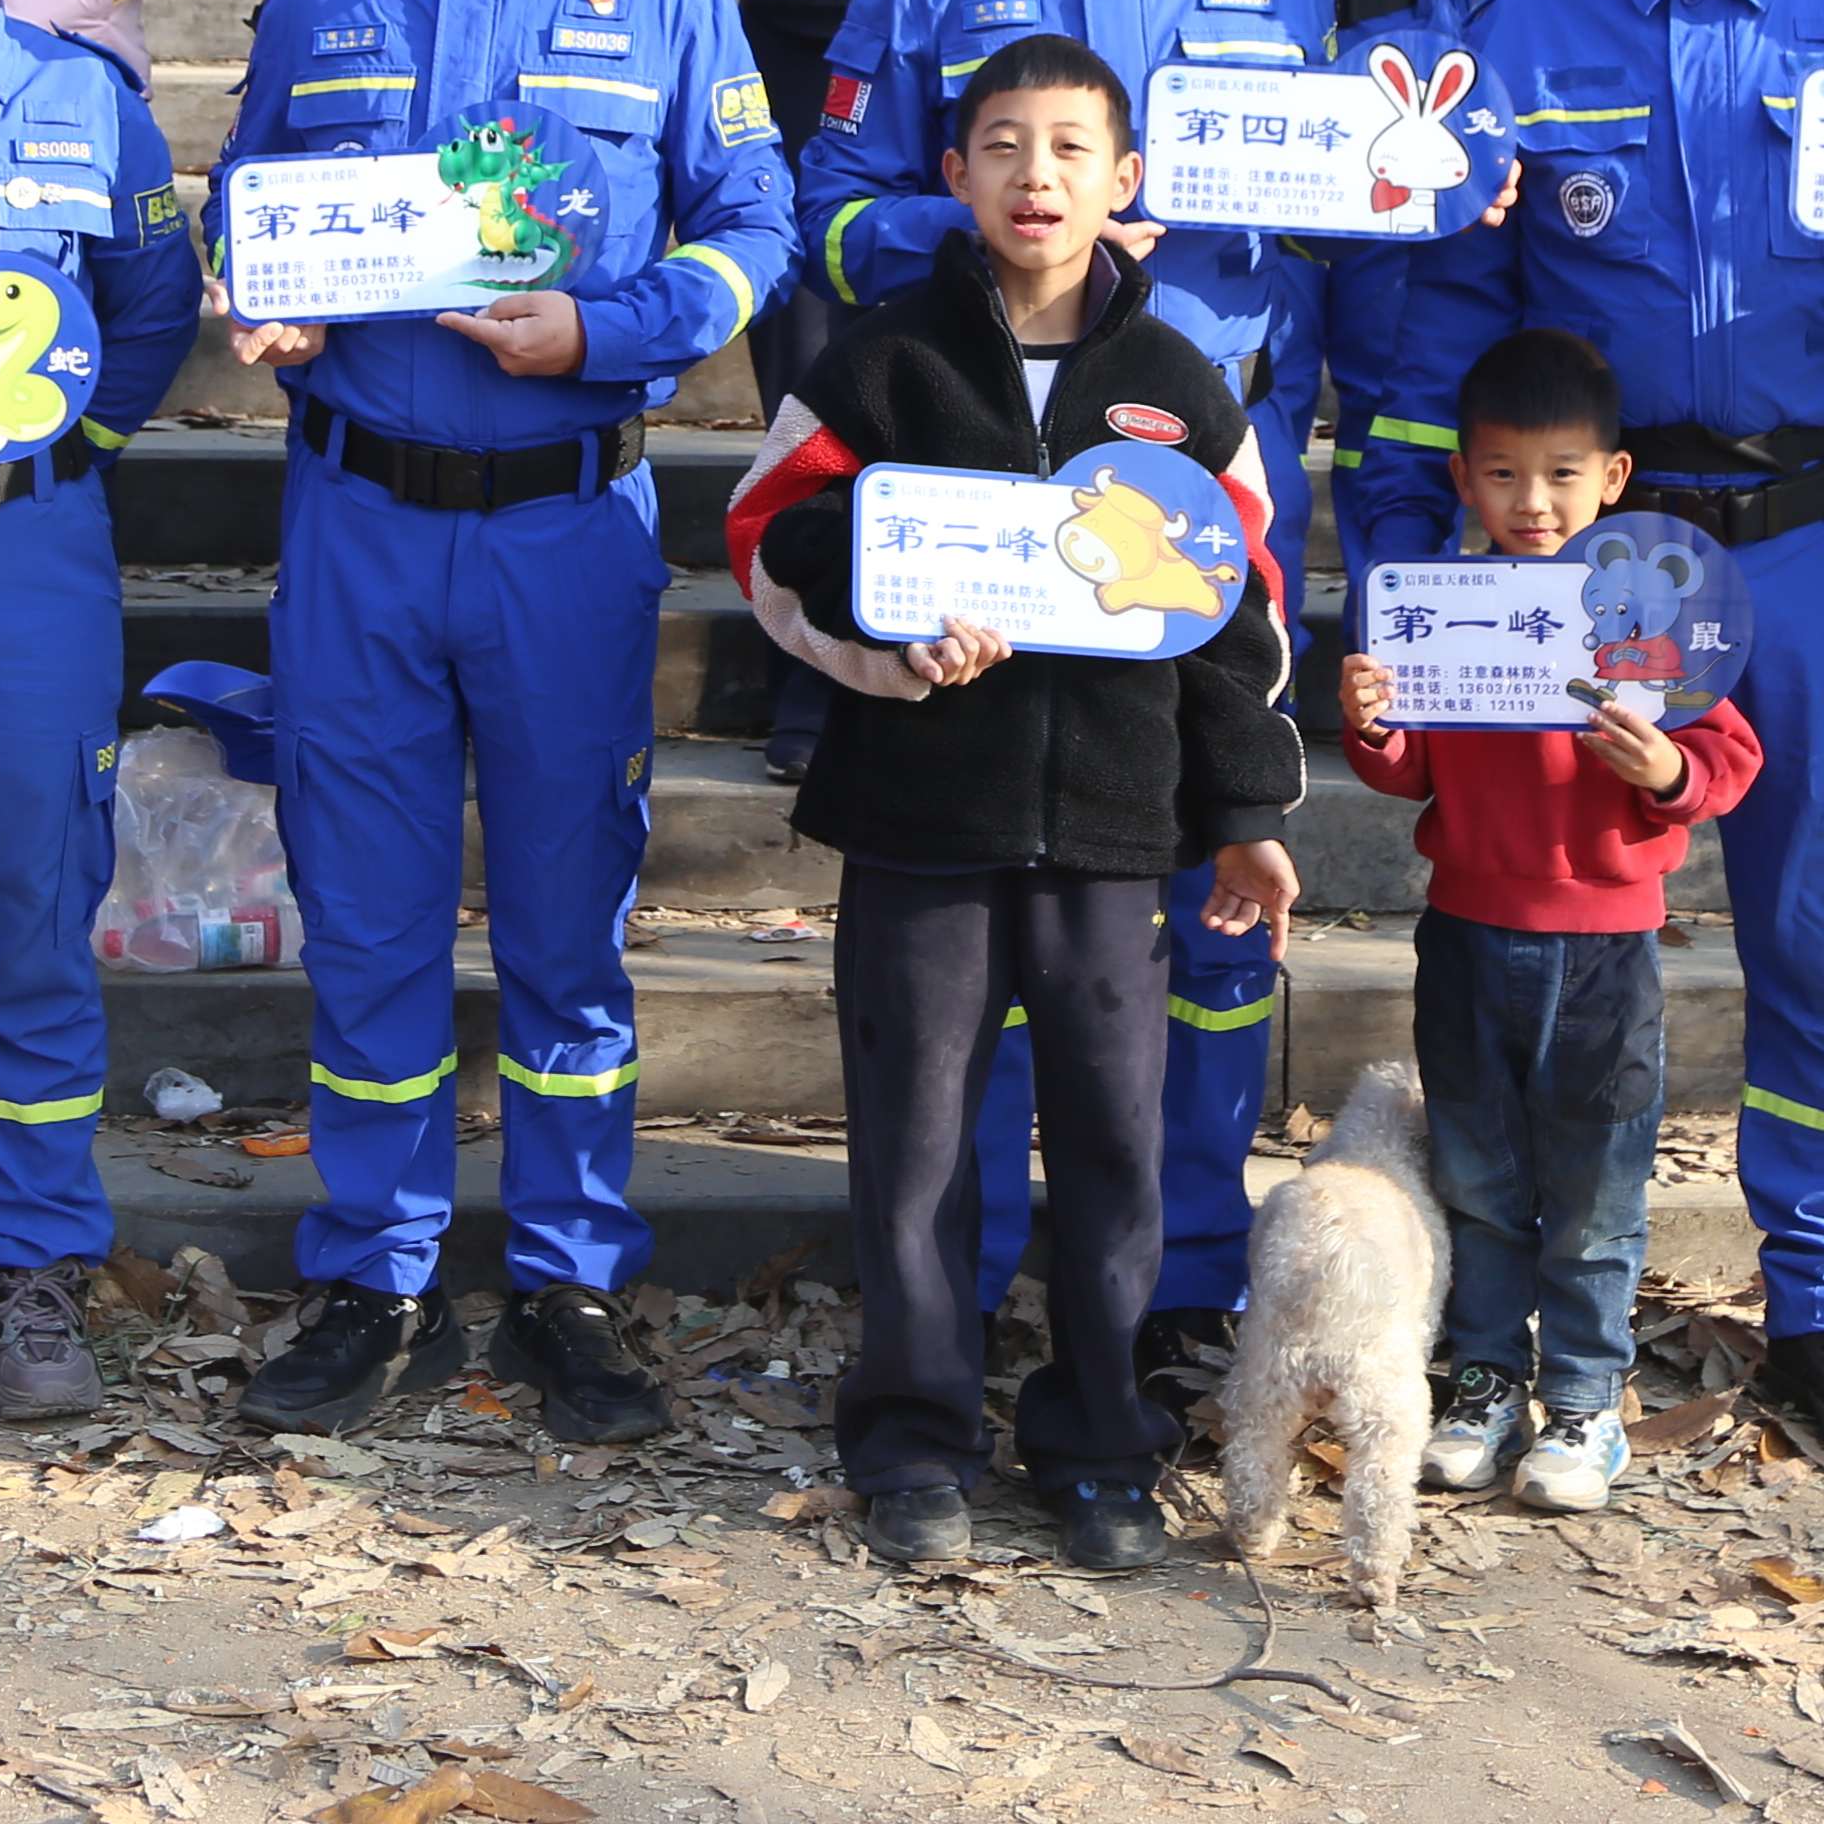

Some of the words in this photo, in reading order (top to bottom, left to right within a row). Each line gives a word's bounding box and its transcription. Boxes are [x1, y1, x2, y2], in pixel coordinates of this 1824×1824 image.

[1175, 107, 1352, 153] 第四峰
[1463, 107, 1507, 138] 兔
[556, 187, 600, 217] 龙
[245, 197, 426, 242] 第五峰
[47, 346, 92, 377] 蛇
[874, 514, 1050, 563] 第二峰
[1193, 523, 1239, 555] 牛
[1404, 572, 1497, 587] 信阳蓝天救援队
[1380, 604, 1566, 645] 第一峰
[1689, 621, 1730, 653] 鼠
[1384, 681, 1560, 696] 援电话：13603761722
